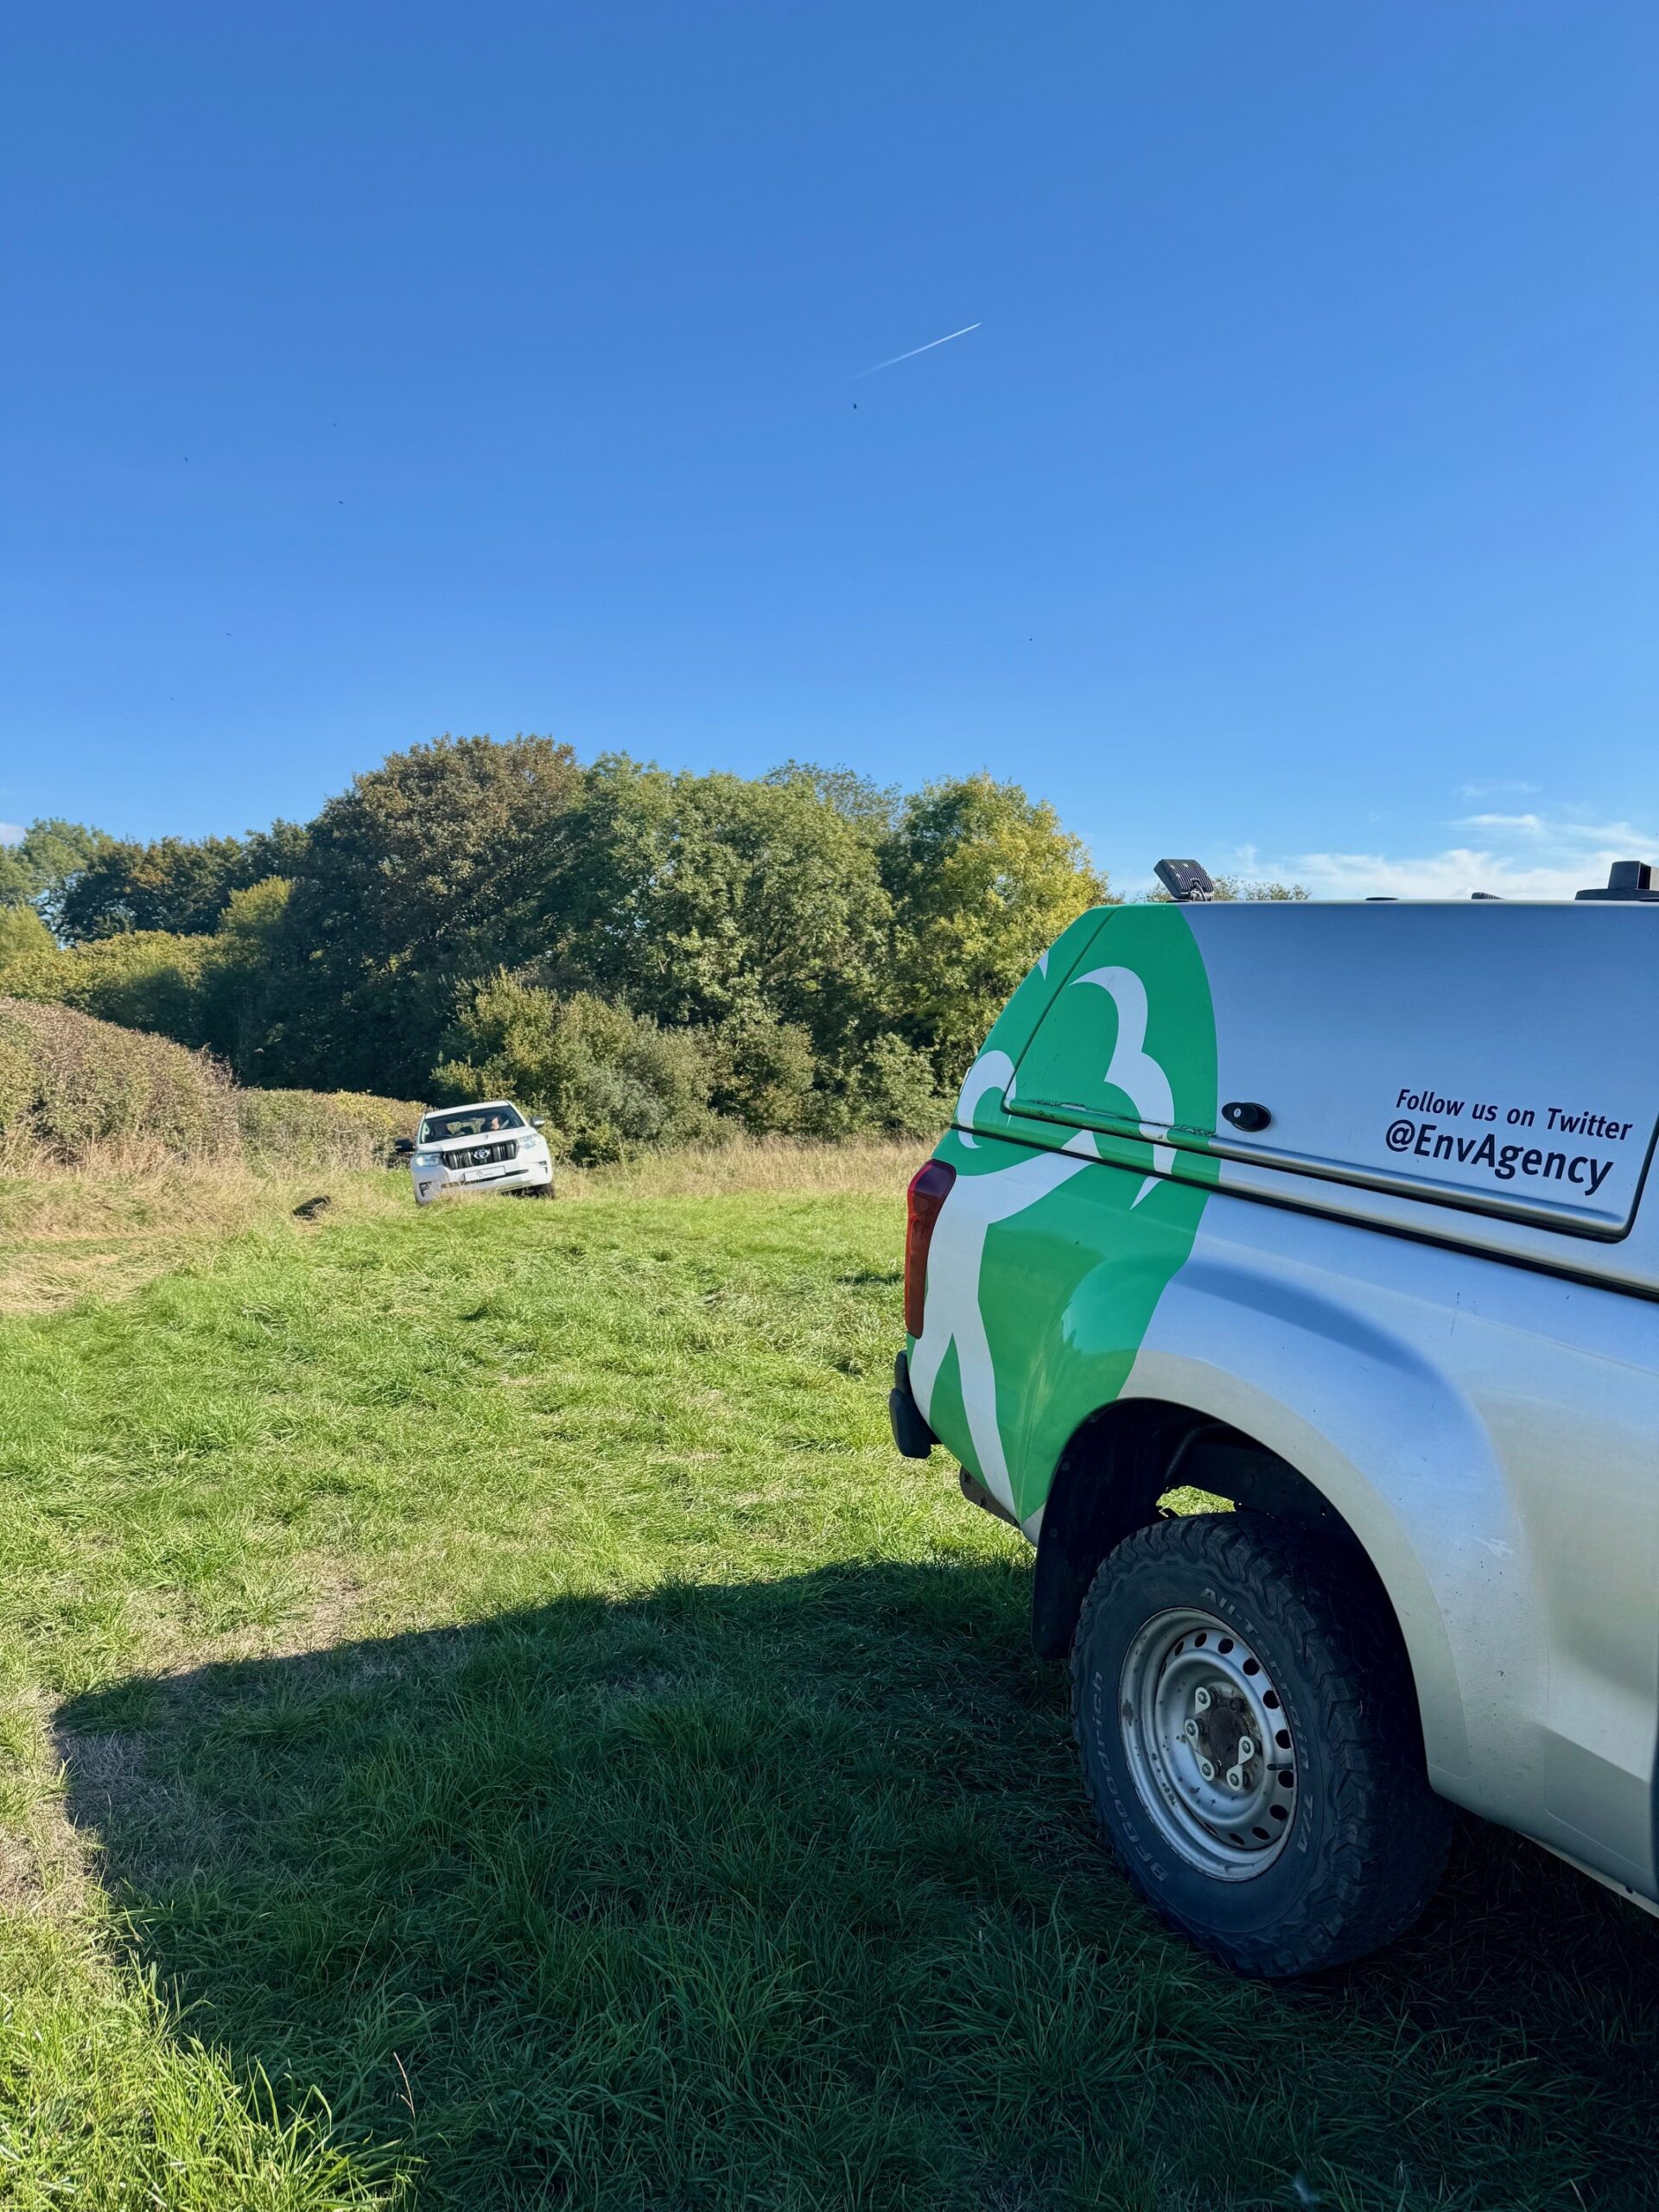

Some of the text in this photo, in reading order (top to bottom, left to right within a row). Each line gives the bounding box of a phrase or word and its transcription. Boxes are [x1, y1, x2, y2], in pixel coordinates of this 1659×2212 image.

[1395, 1089, 1633, 1141] Follow us on Twitter
[1385, 1119, 1614, 1196] @EnvAgency
[1092, 1671, 1168, 1882] BFGoodrich
[1297, 1795, 1313, 1853] T/A
